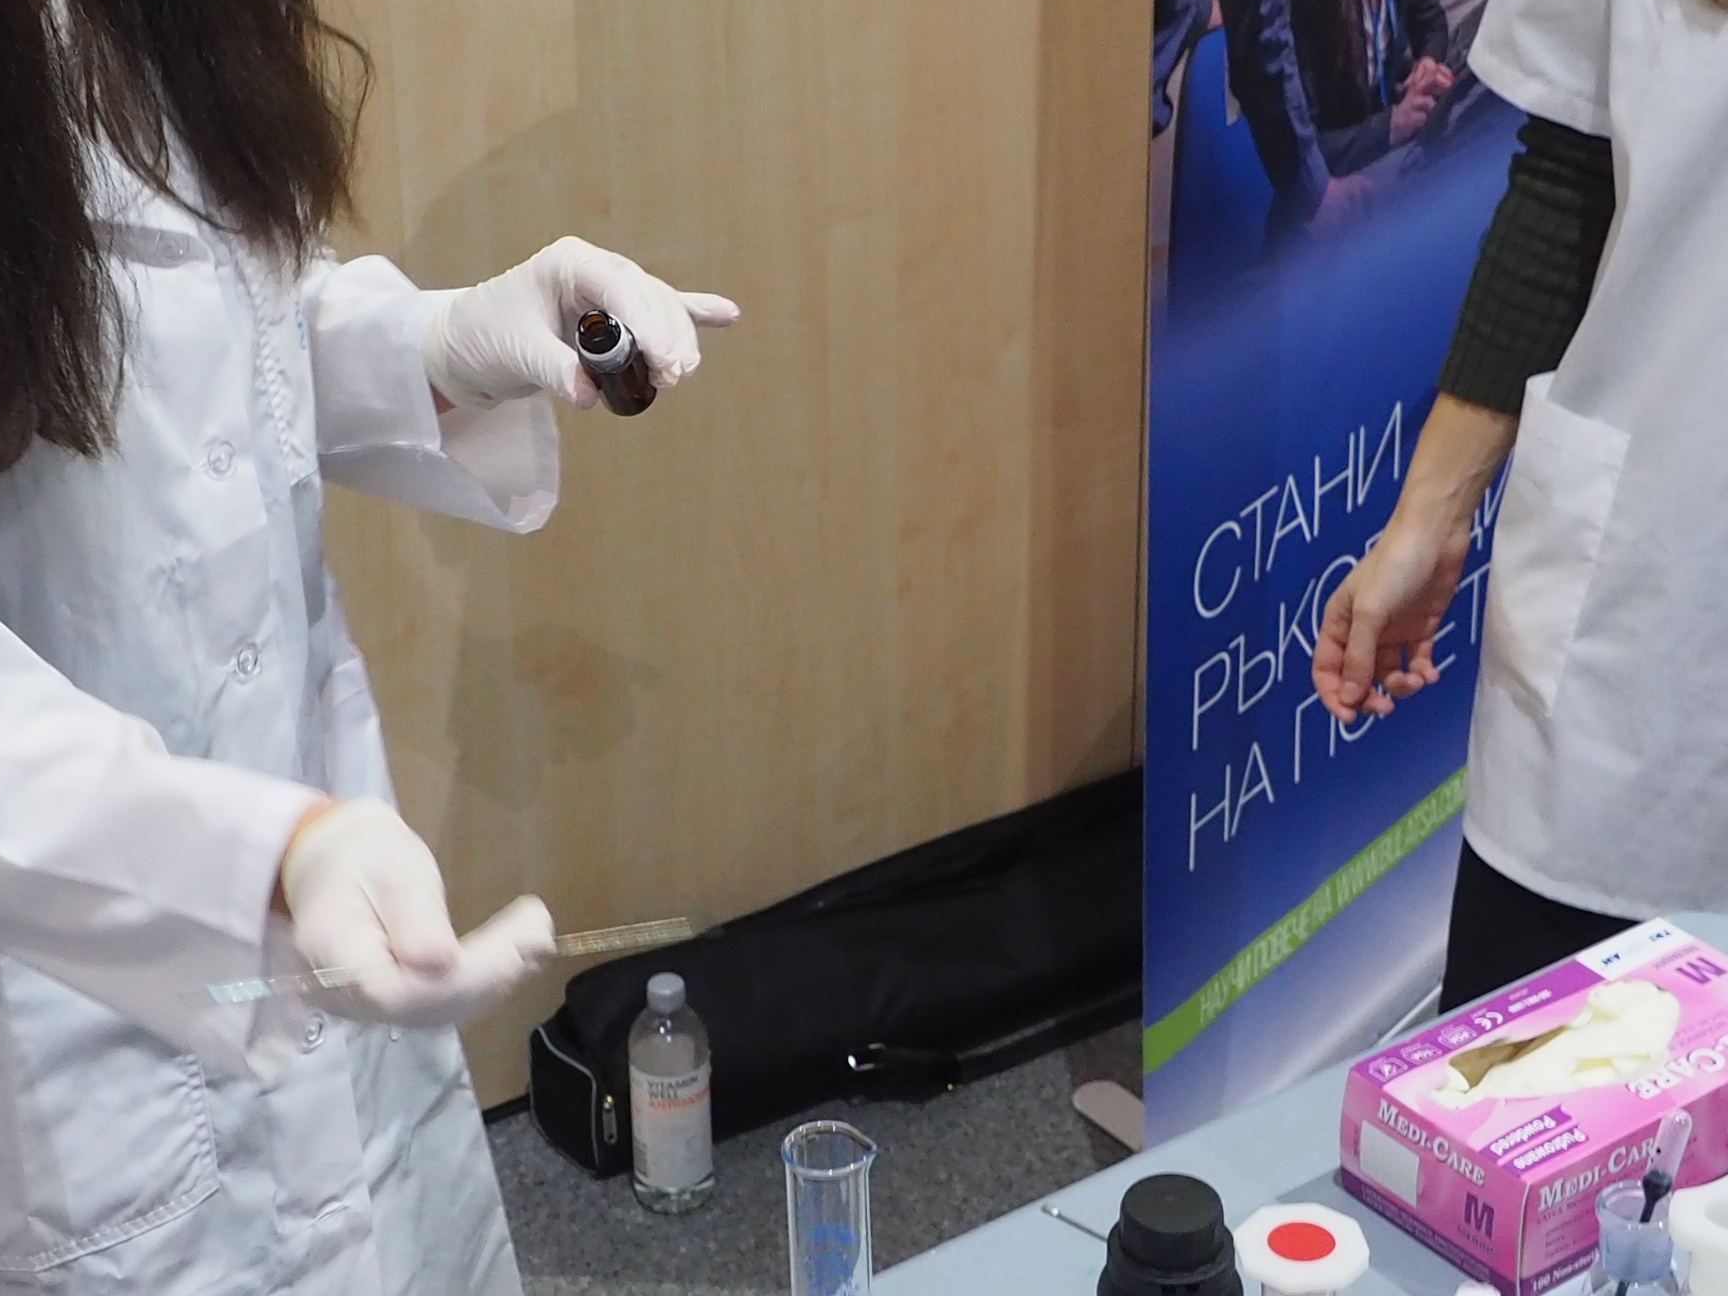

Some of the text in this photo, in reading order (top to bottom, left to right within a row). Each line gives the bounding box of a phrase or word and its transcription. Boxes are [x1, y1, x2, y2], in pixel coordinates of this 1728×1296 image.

[1193, 400, 1403, 620] СТАНИ
[1189, 741, 1275, 873] НА
[1377, 1097, 1486, 1187] MEDI-CARE
[1489, 1114, 1557, 1157] Powdered
[1463, 1191, 1495, 1241] M
